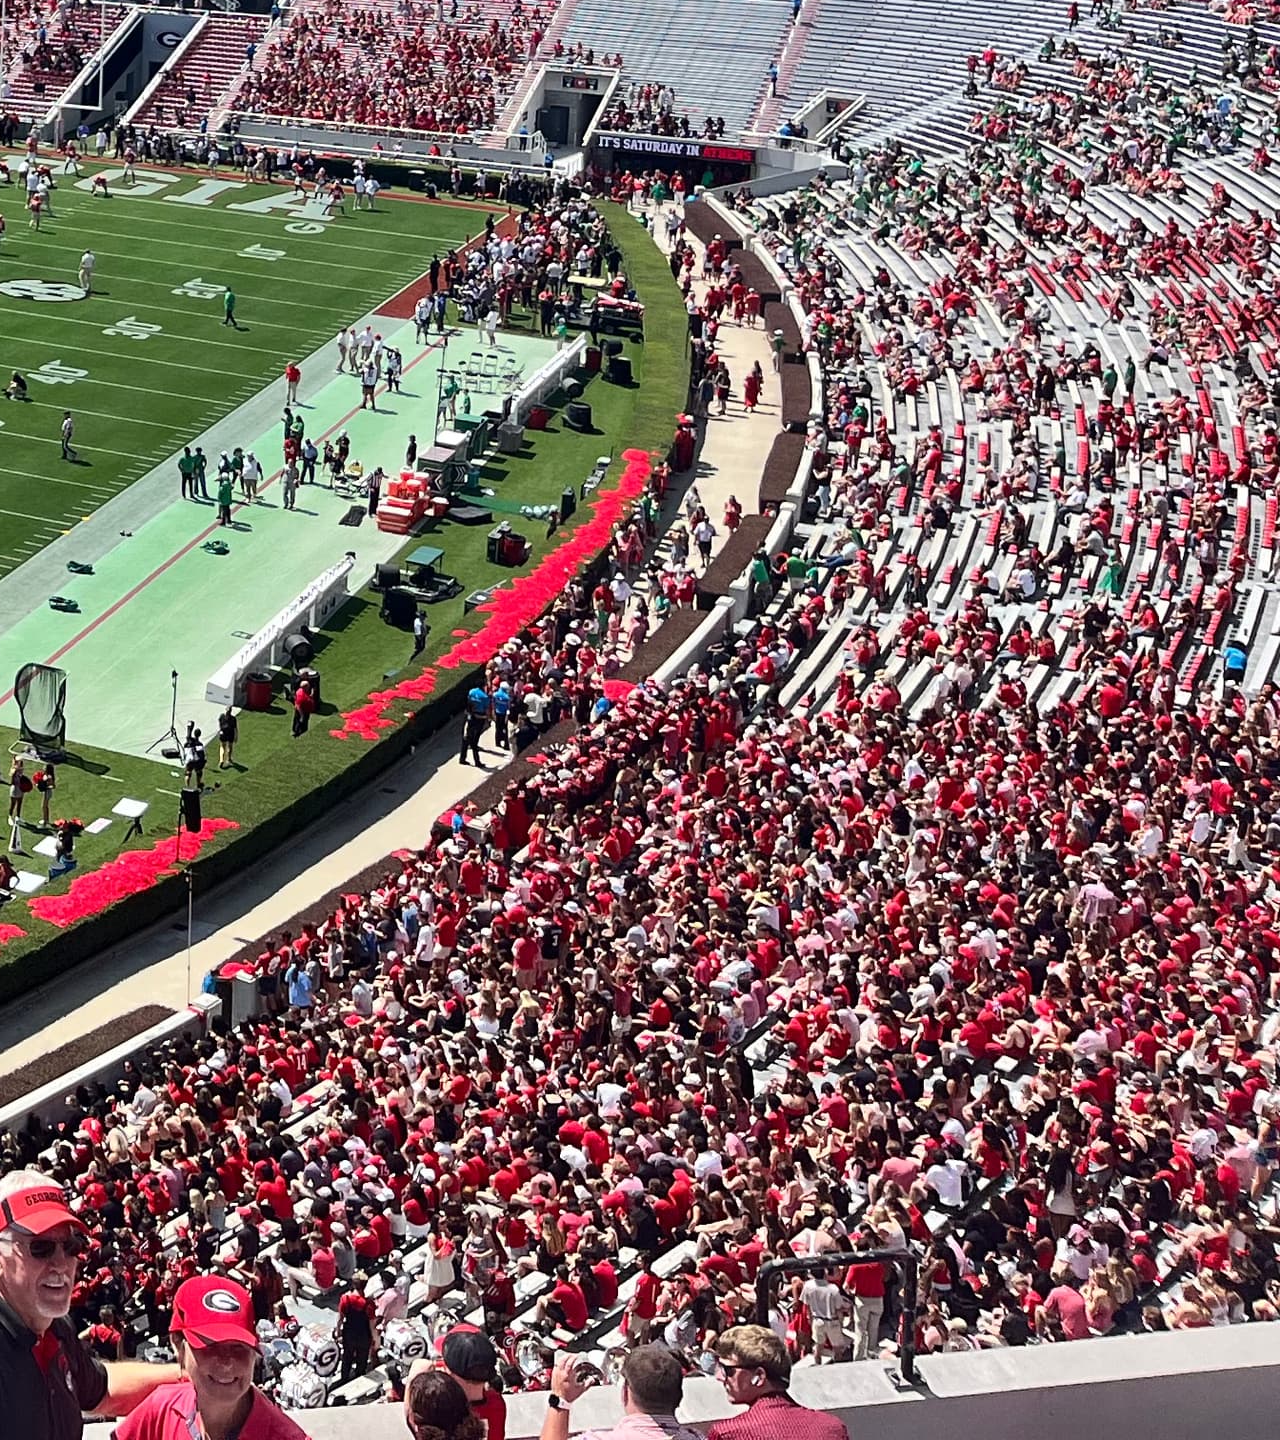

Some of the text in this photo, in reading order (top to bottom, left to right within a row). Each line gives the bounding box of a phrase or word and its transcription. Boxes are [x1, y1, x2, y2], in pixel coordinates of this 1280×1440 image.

[598, 135, 621, 148] IT'S
[623, 137, 684, 156] SATURDAY
[686, 144, 700, 157] IN
[236, 245, 287, 261] 10
[171, 279, 228, 300] 20
[102, 319, 163, 340] 30
[27, 362, 89, 386] 40
[202, 1289, 241, 1314] G
